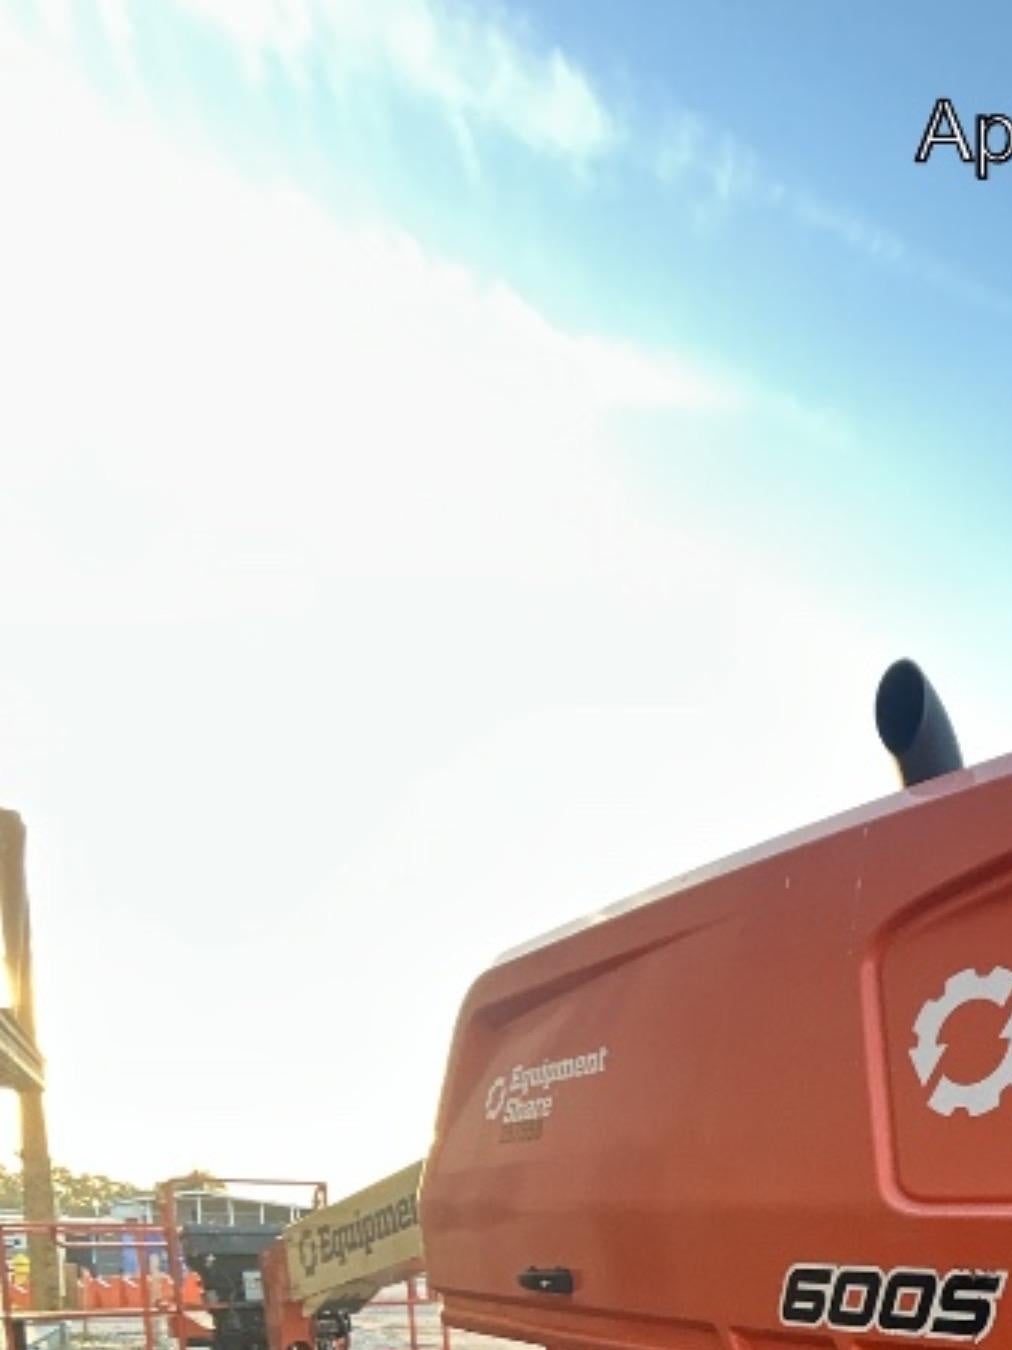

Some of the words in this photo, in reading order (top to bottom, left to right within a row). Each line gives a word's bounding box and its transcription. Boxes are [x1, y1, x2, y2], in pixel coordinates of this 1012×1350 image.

[509, 1046, 608, 1096] Equipment
[503, 1096, 553, 1124] Share
[779, 1262, 1008, 1344] 600S
